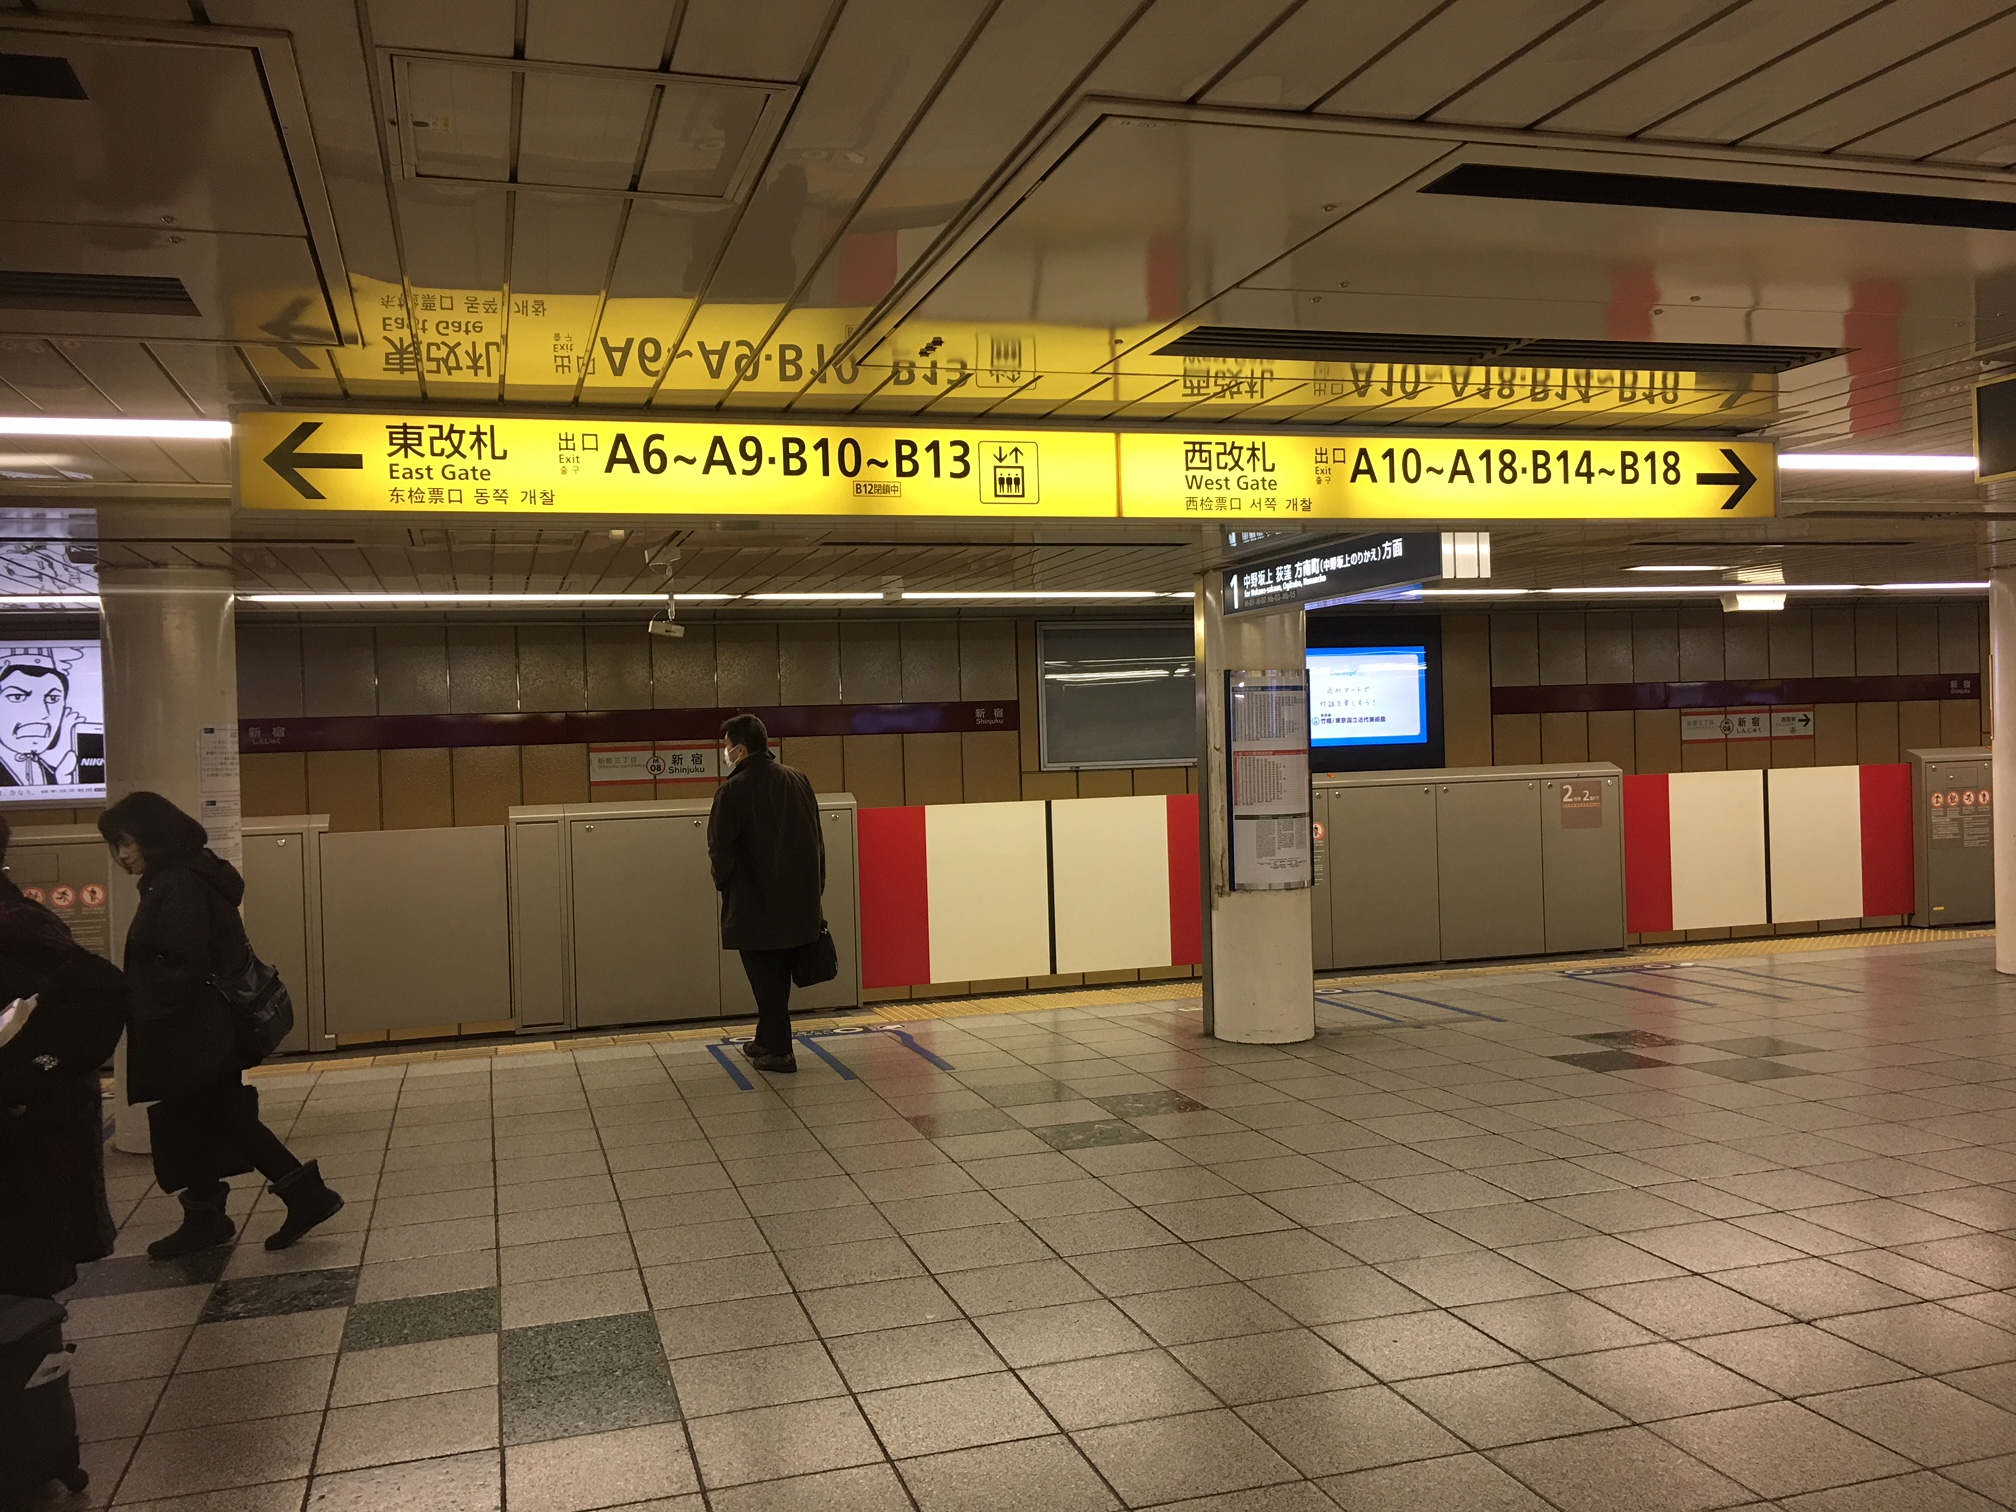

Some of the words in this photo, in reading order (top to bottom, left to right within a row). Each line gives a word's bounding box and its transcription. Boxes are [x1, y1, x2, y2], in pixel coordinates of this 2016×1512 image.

[386, 423, 508, 461] 東改札
[558, 432, 599, 452] 出口
[558, 454, 580, 465] Exit
[1183, 440, 1276, 473] 西改札
[1314, 447, 1346, 465] 出口
[389, 464, 434, 482] East
[441, 463, 492, 482] Gate
[1315, 466, 1332, 476] Exit
[855, 482, 900, 497] B12閉鎖中
[1185, 474, 1231, 491] West
[1236, 475, 1278, 491] Gate
[388, 486, 464, 505] 东检票口
[473, 488, 510, 506] 동쪽
[520, 489, 556, 507] 개찰
[1185, 496, 1242, 511] 西检票口
[1249, 497, 1278, 512] 서쪽
[1285, 497, 1313, 512] 개찰
[1230, 574, 1239, 609] 1
[1243, 568, 1274, 589] 中野坂上
[974, 707, 1004, 718] 新宿
[1737, 716, 1760, 728] 新宿
[248, 726, 286, 738] 新宿
[671, 752, 704, 767] 新宿
[649, 764, 662, 773] 08
[668, 765, 706, 775] Shinjuku
